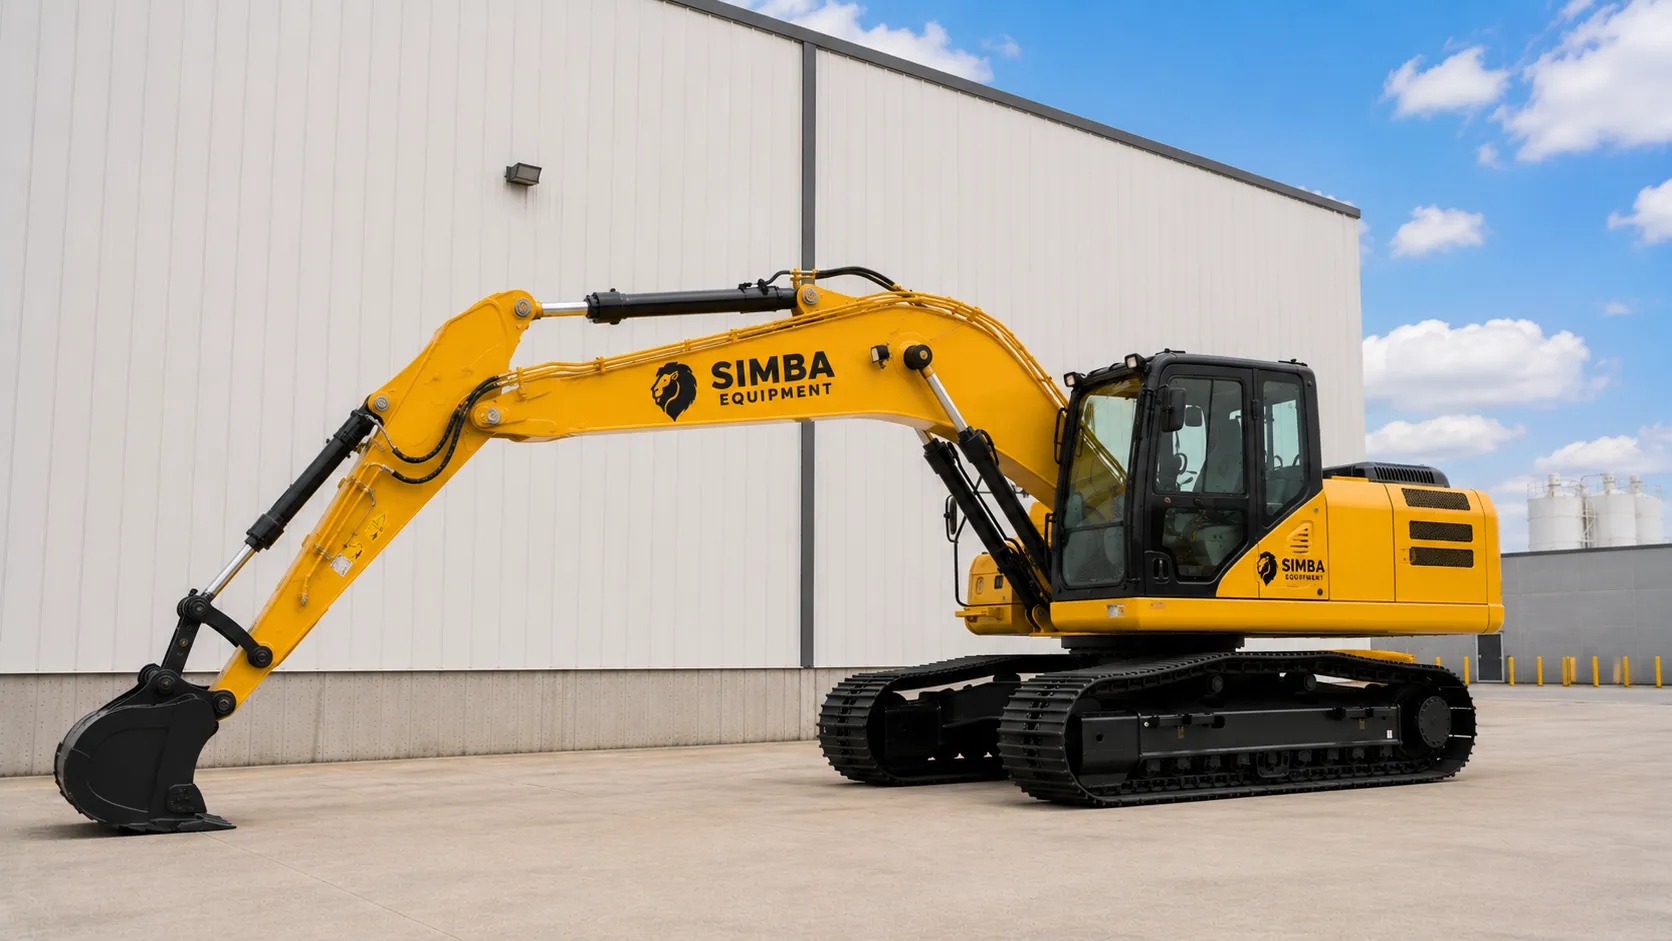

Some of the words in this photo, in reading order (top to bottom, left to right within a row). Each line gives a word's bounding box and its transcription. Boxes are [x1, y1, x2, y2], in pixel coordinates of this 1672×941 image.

[711, 351, 835, 389] SIMBA
[719, 383, 832, 406] EQUIPMENT
[1281, 558, 1325, 573] SIMBA
